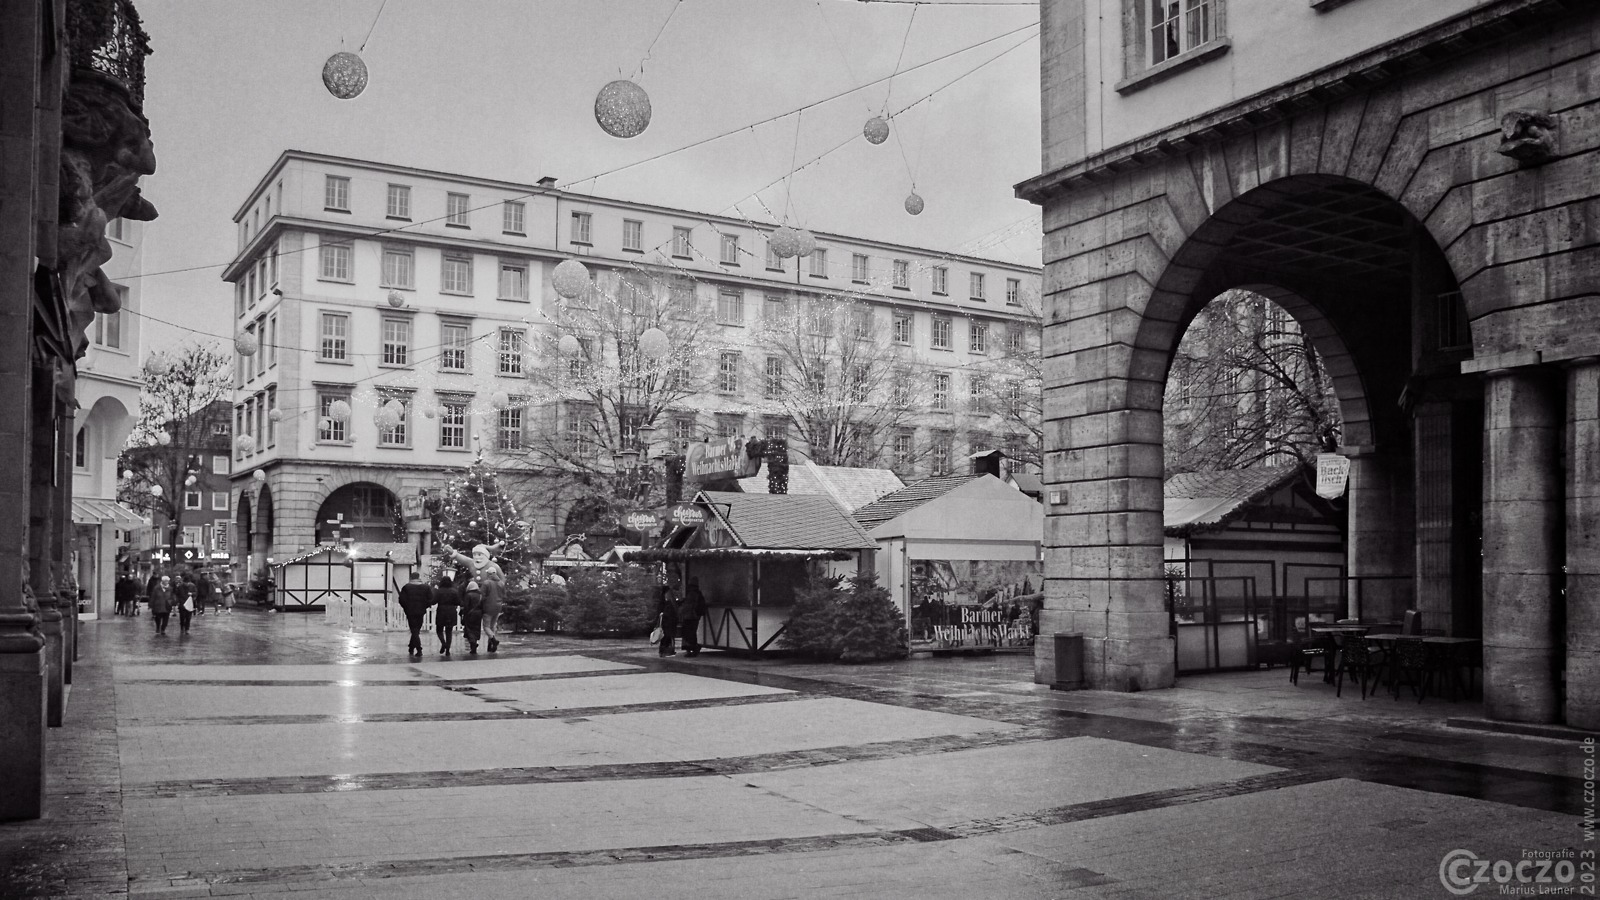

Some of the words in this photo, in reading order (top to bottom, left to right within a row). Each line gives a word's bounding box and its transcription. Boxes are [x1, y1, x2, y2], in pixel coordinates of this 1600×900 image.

[705, 444, 727, 459] Barmer
[961, 607, 1003, 623] Barmer
[933, 624, 1030, 641] WeihnachtsMarkt
